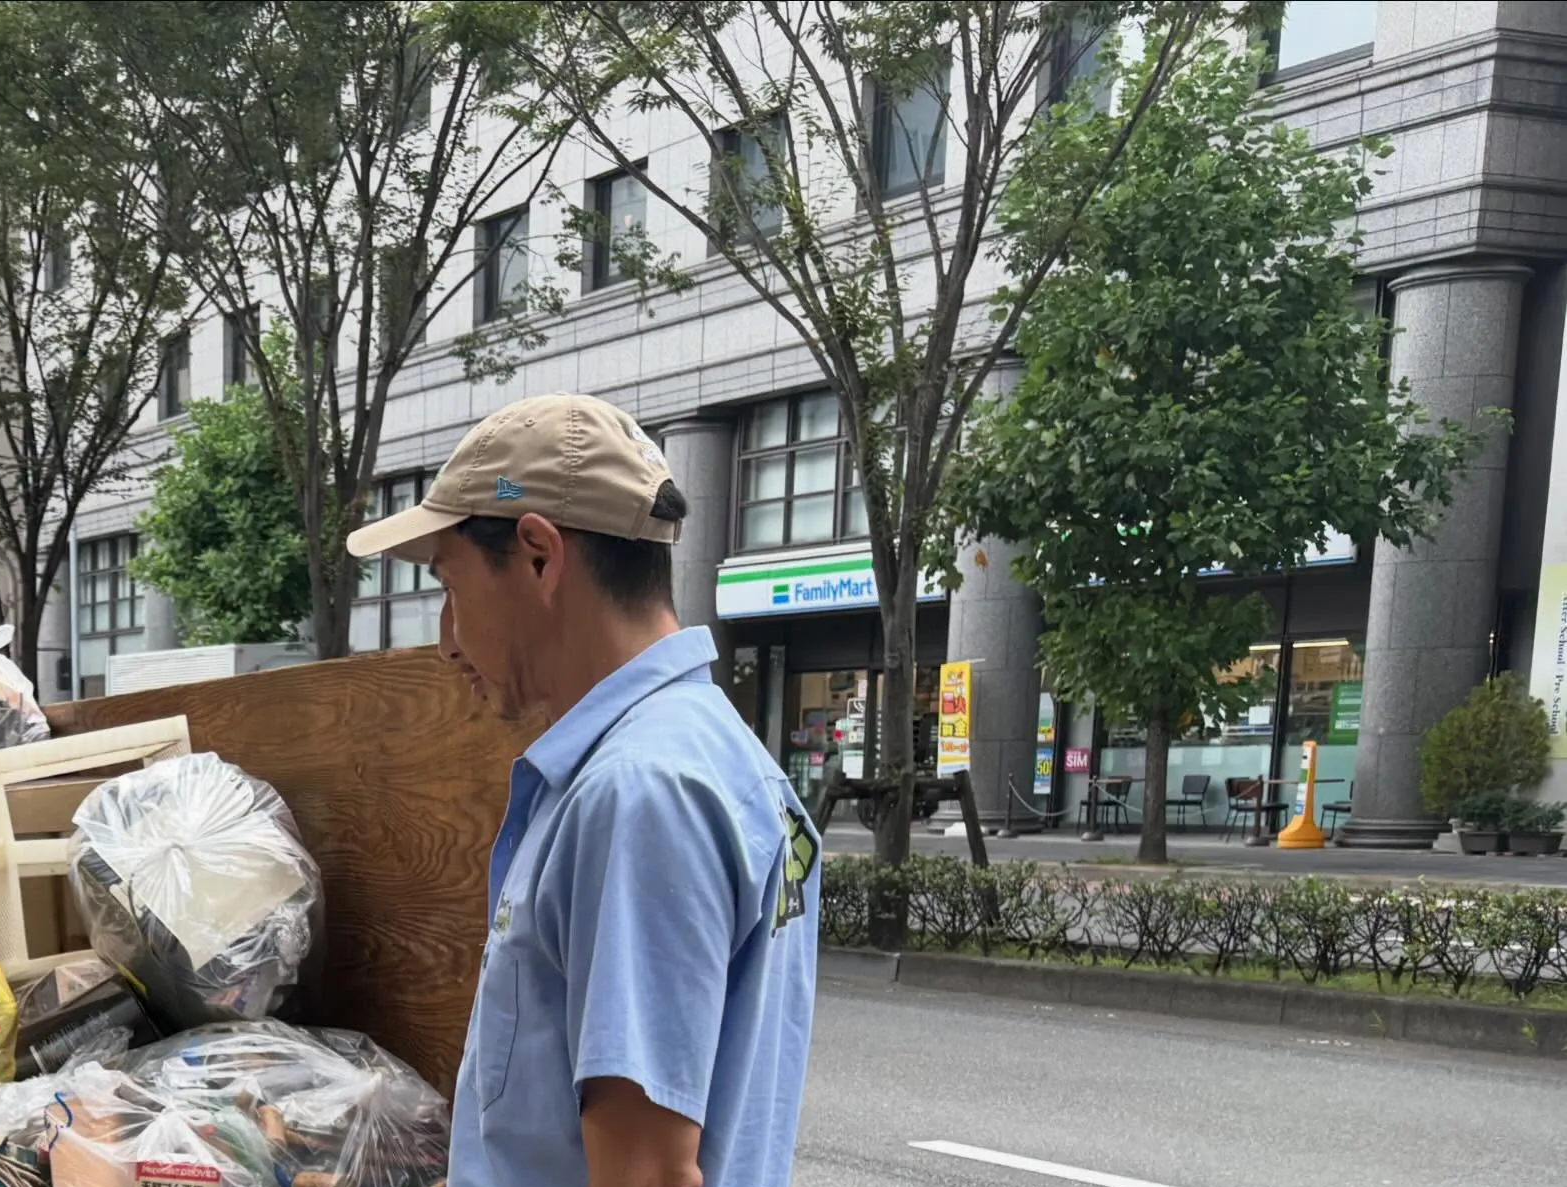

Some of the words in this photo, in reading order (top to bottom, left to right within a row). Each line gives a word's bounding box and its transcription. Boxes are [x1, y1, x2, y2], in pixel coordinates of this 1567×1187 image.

[794, 577, 873, 602] FamilyMart
[1556, 627, 1566, 665] School
[1553, 674, 1564, 694] Pre
[1066, 754, 1088, 767] SIM
